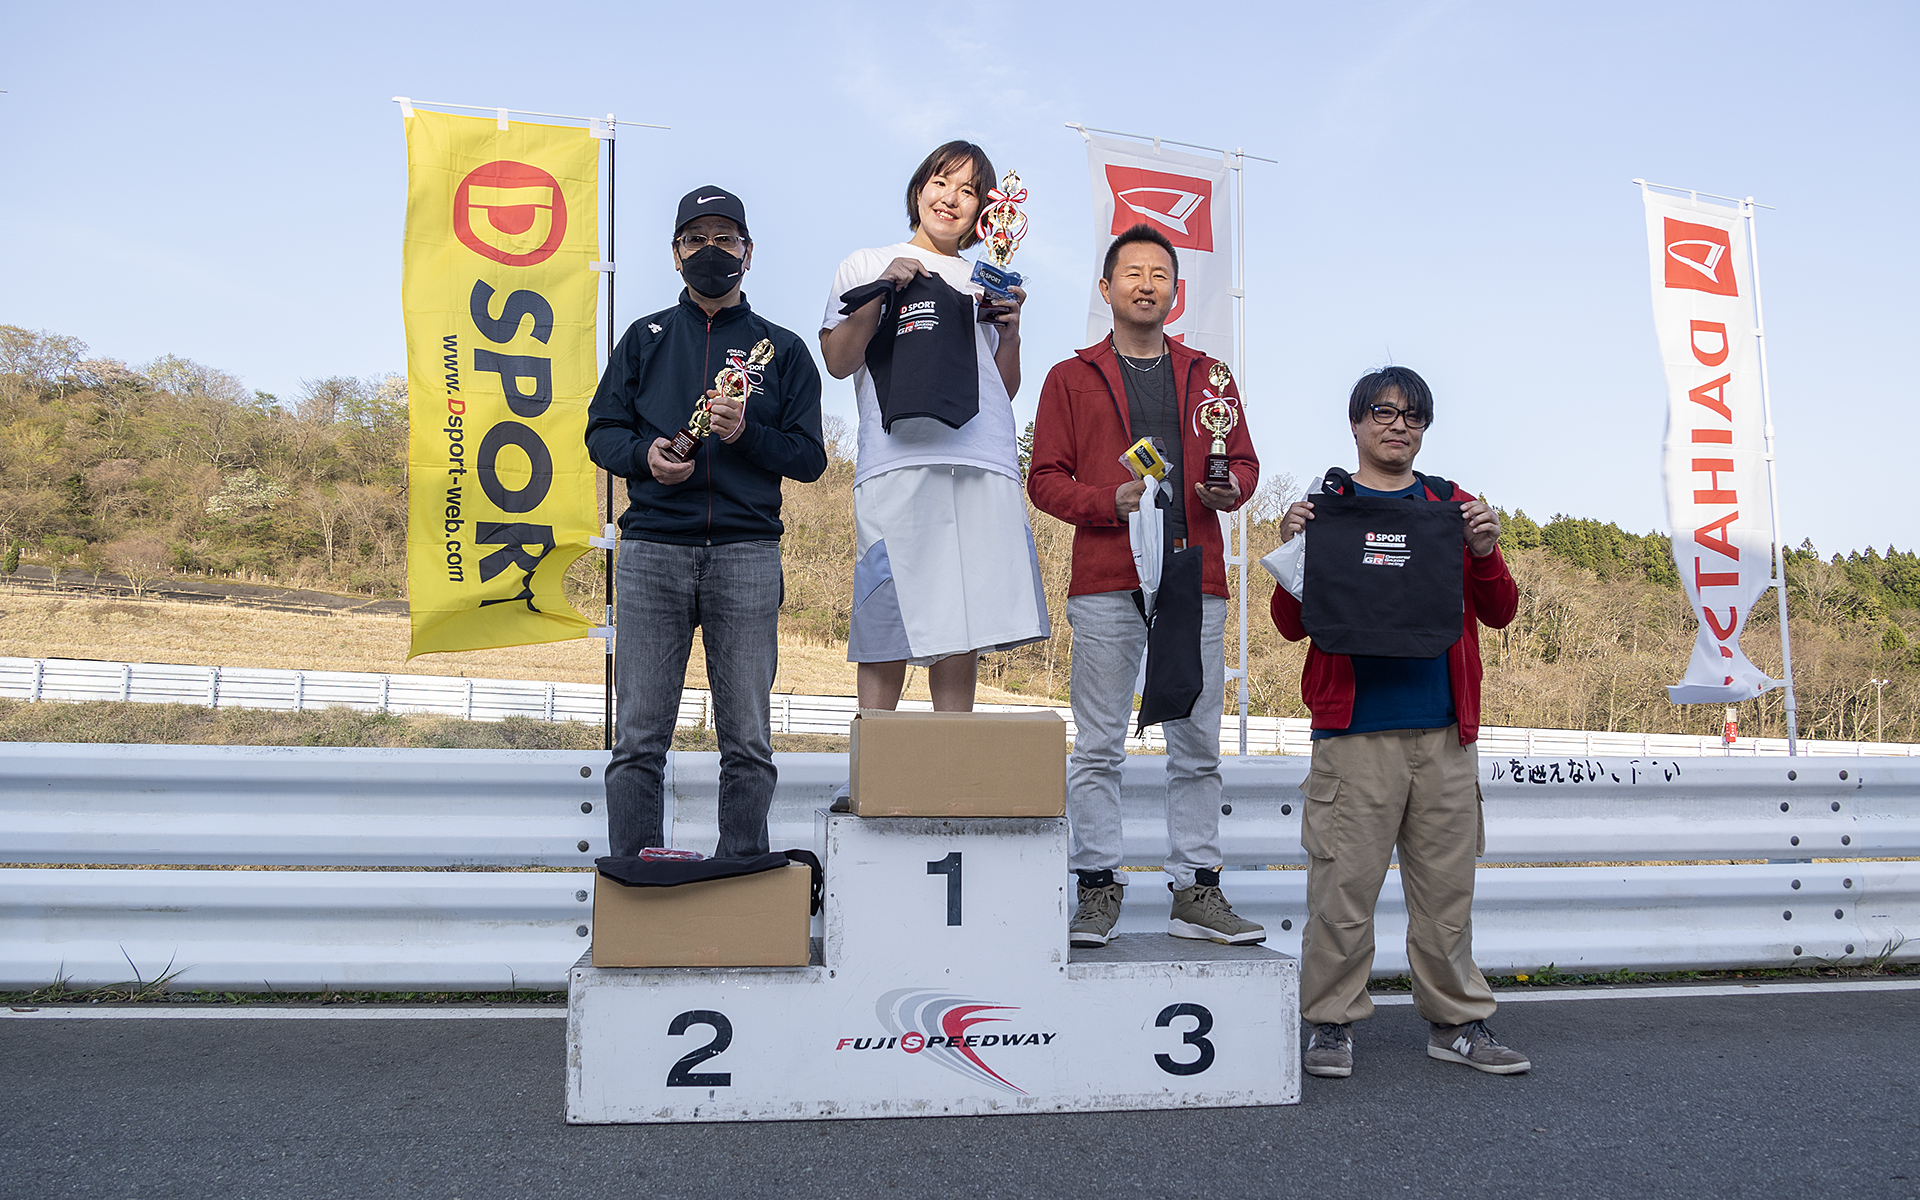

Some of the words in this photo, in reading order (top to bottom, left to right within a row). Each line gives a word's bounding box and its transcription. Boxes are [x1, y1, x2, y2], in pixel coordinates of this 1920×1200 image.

[985, 272, 1001, 283] SPORT
[908, 300, 936, 312] SPORT
[442, 334, 467, 583] www.Dsport-web.com
[1141, 452, 1152, 466] SPORT
[1376, 533, 1407, 542] SPORT
[1364, 556, 1383, 564] GR
[926, 851, 963, 927] 1
[666, 1009, 733, 1088] 2
[835, 1037, 898, 1051] FUJI
[901, 1031, 1057, 1054] SPEEDWAY
[1154, 1002, 1215, 1077] 3
